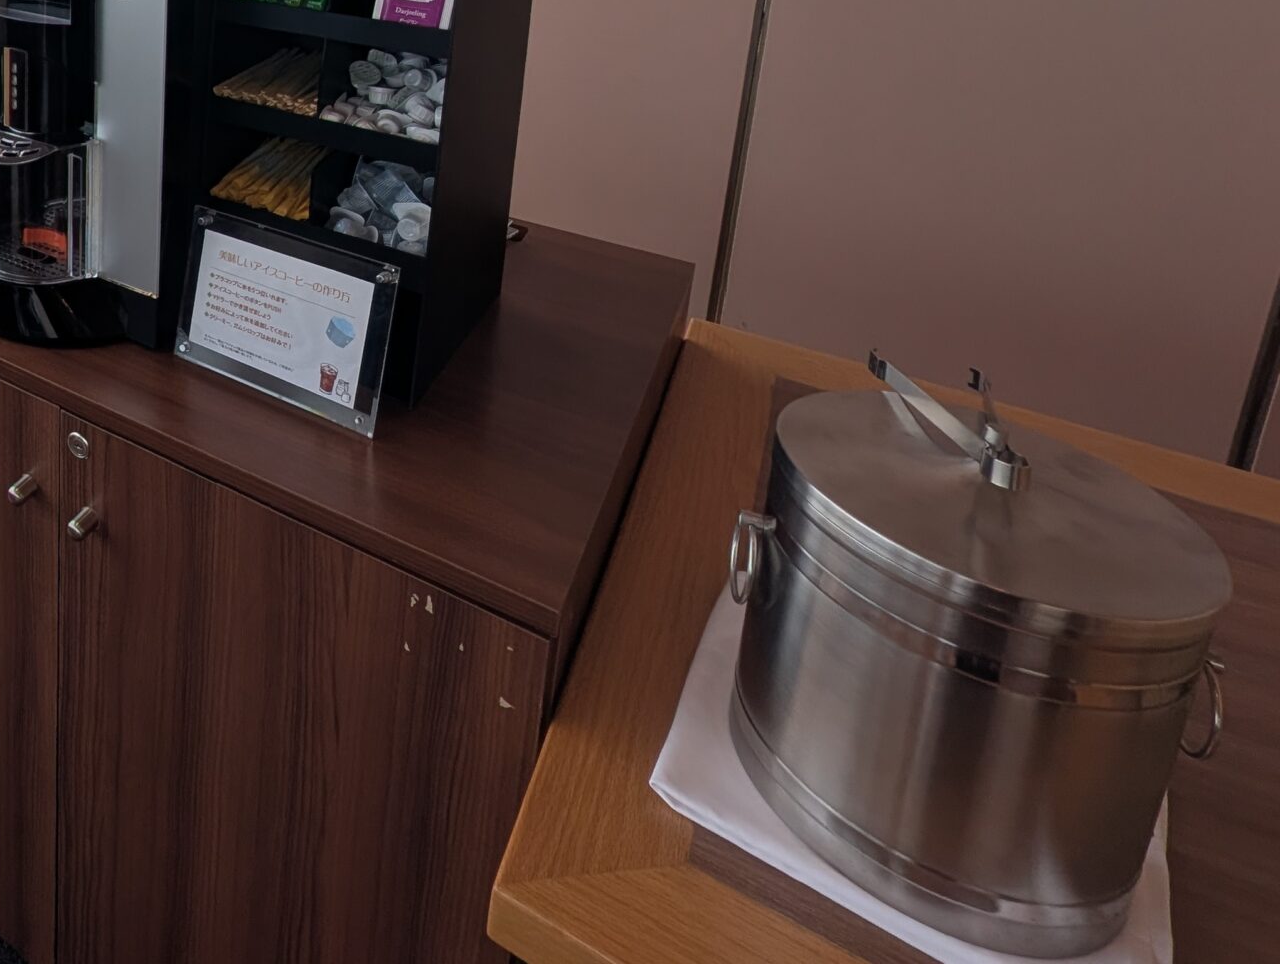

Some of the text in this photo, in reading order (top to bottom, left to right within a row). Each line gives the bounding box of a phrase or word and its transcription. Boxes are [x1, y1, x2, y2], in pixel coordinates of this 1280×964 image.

[395, 7, 427, 19] Darjeeling
[218, 249, 351, 303] 美味しいアイスコーヒーの作り方
